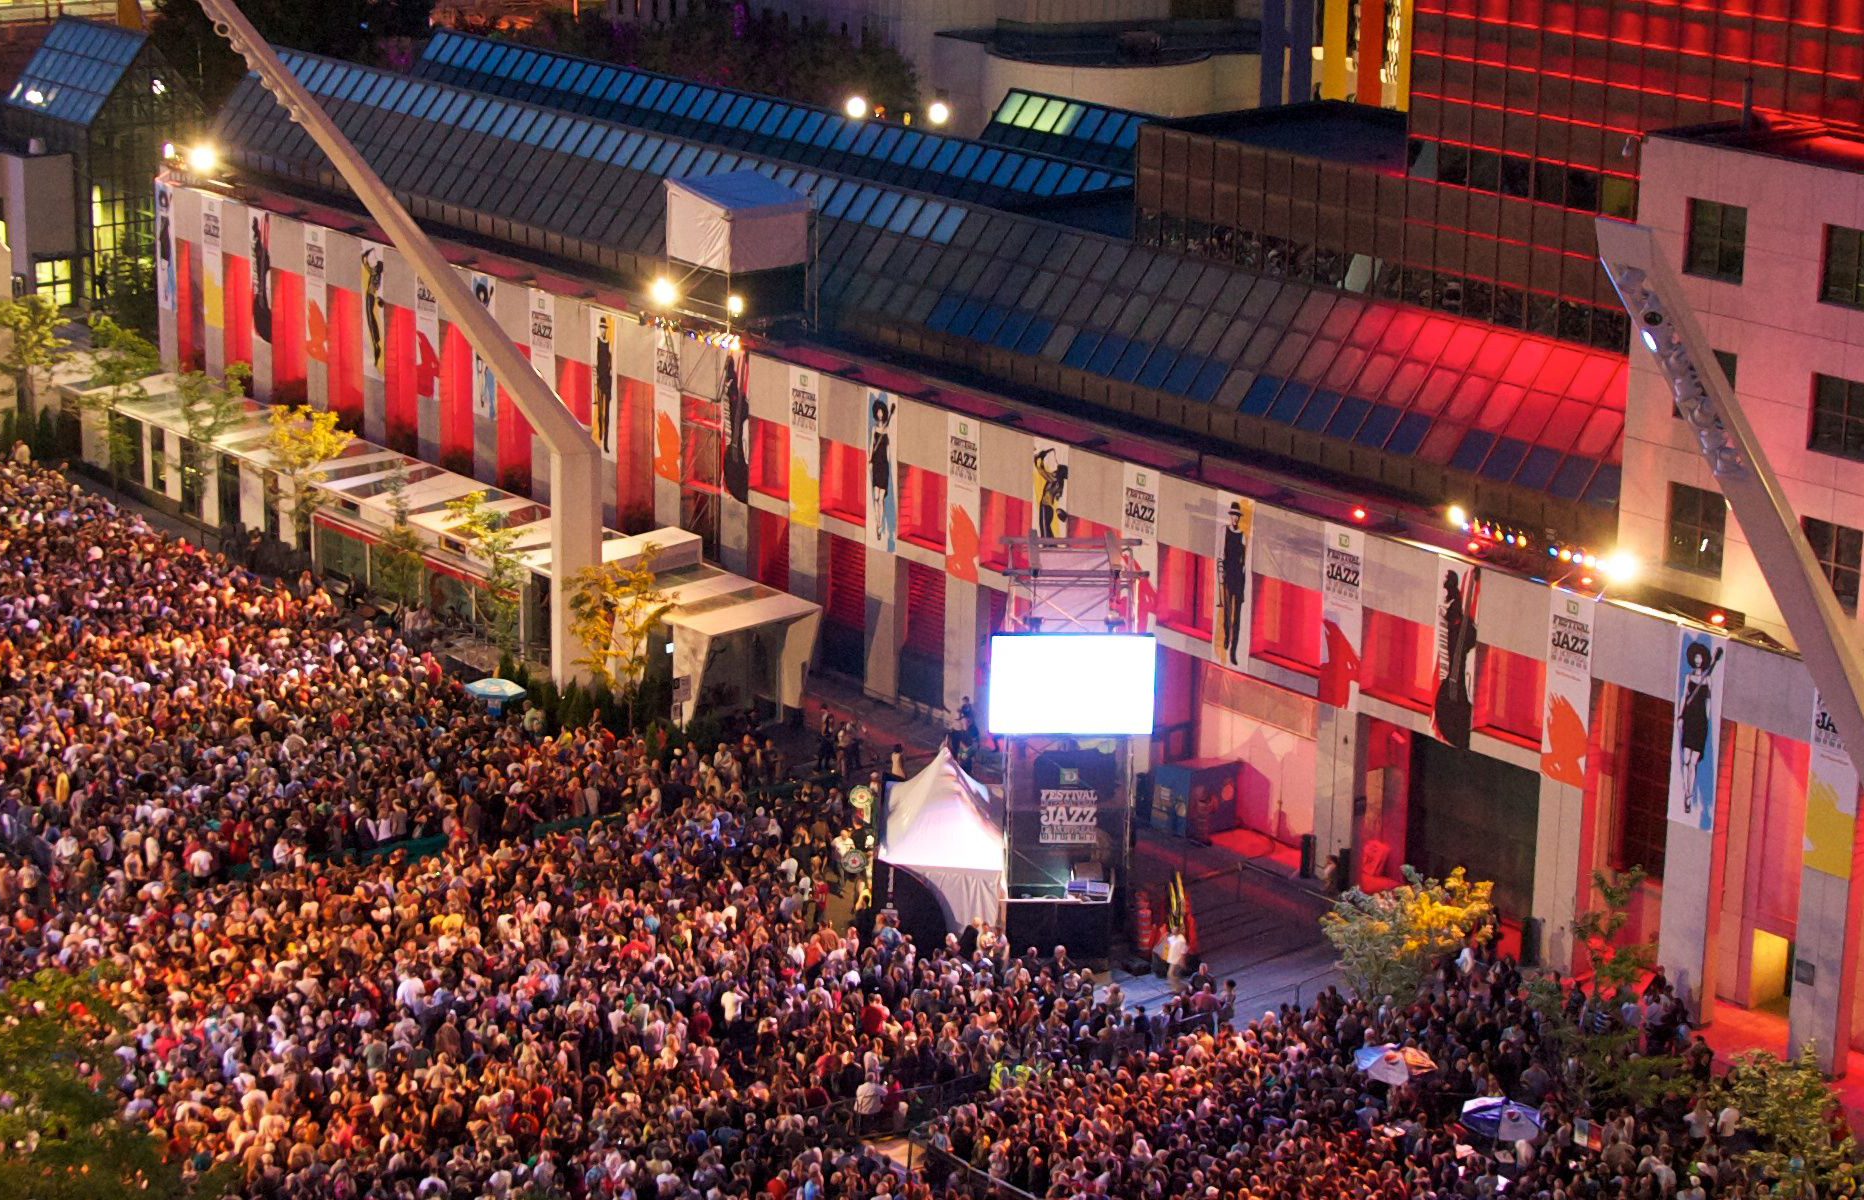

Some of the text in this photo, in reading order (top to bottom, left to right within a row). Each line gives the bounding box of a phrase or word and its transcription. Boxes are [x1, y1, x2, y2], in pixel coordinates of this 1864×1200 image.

[792, 401, 817, 420] JAZZ
[951, 450, 977, 470] JAZZ
[1126, 502, 1155, 524] JAZZ
[1326, 563, 1360, 587] JAZZ
[1552, 630, 1589, 656] JAZZ
[1040, 789, 1098, 801] FESTIVAL
[1040, 805, 1098, 825] JAZZ
